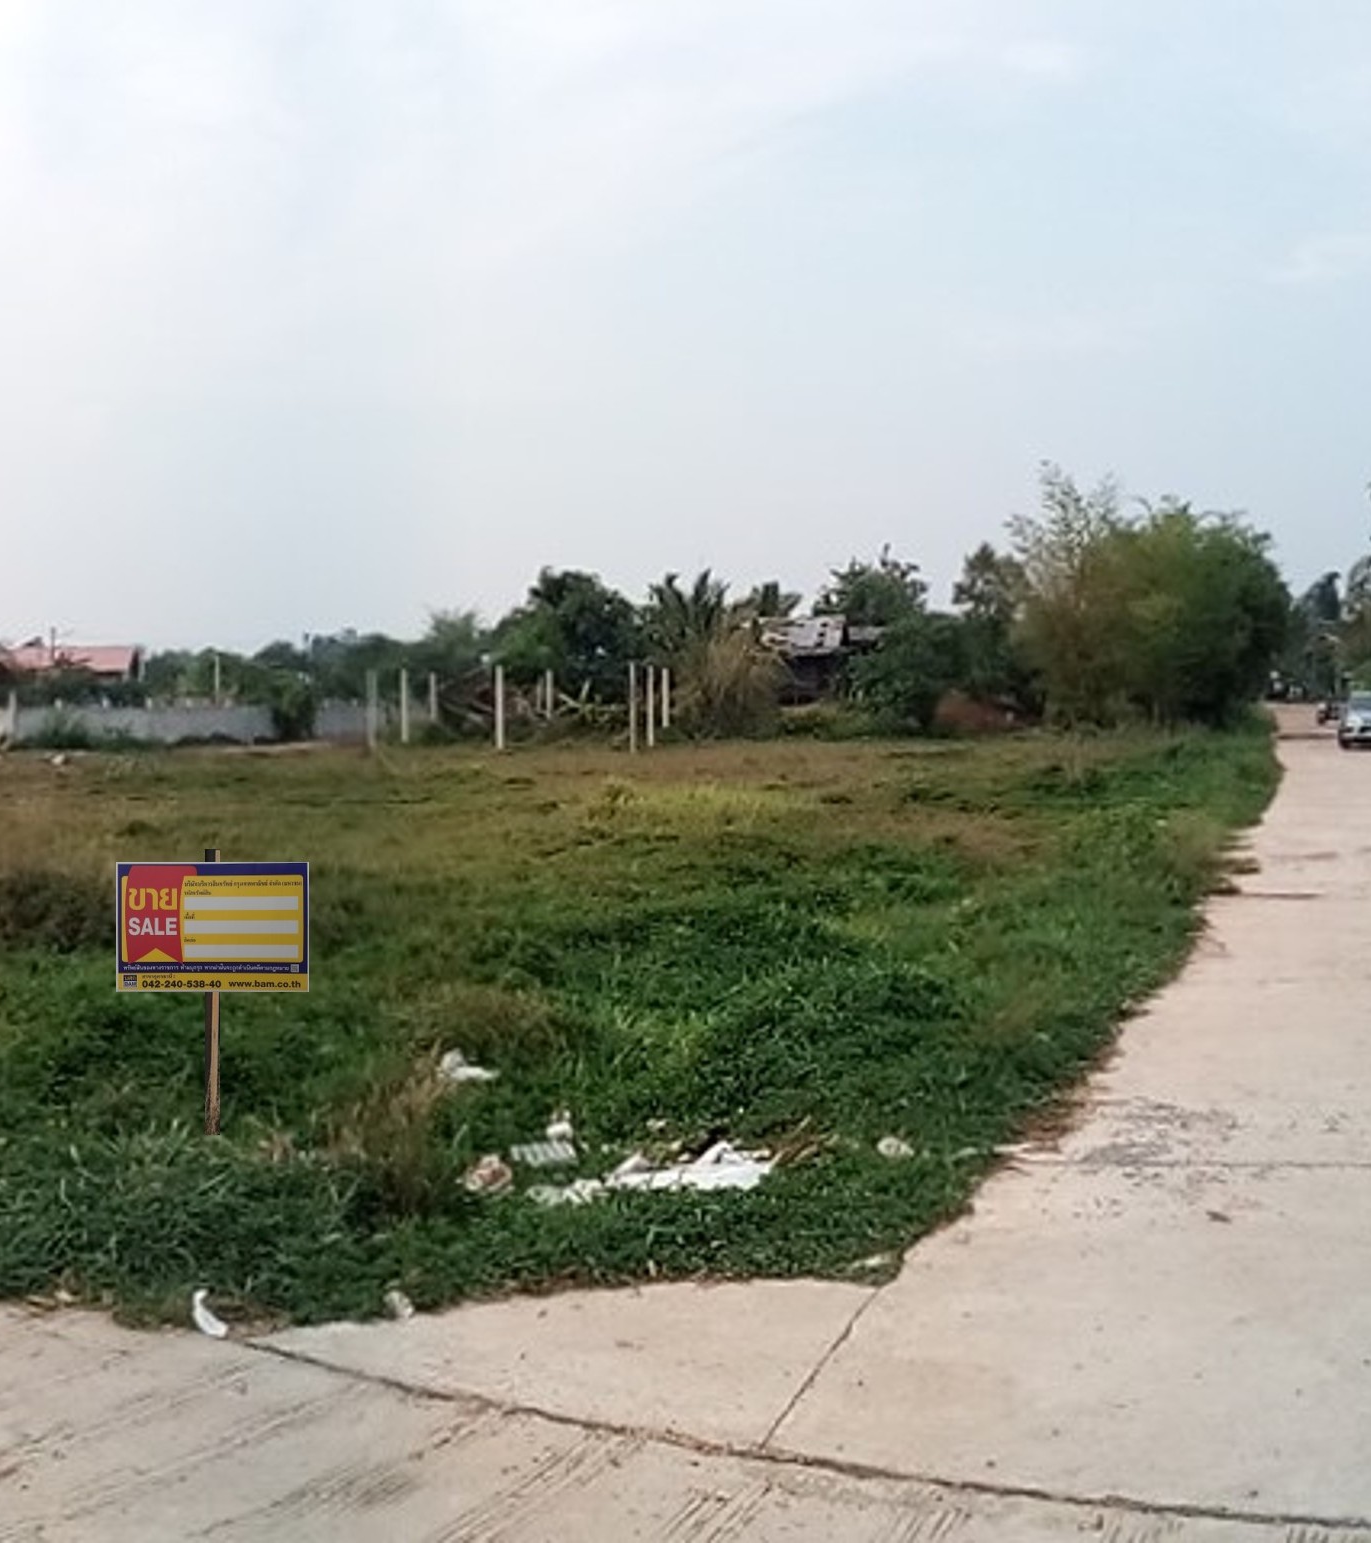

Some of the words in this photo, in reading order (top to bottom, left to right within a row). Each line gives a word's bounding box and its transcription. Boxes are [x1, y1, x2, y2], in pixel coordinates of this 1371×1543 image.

[128, 888, 177, 910] ขาย
[128, 917, 177, 935] SALE
[142, 980, 222, 988] 042-240-538-40
[228, 980, 301, 988] www.bam.co.th
